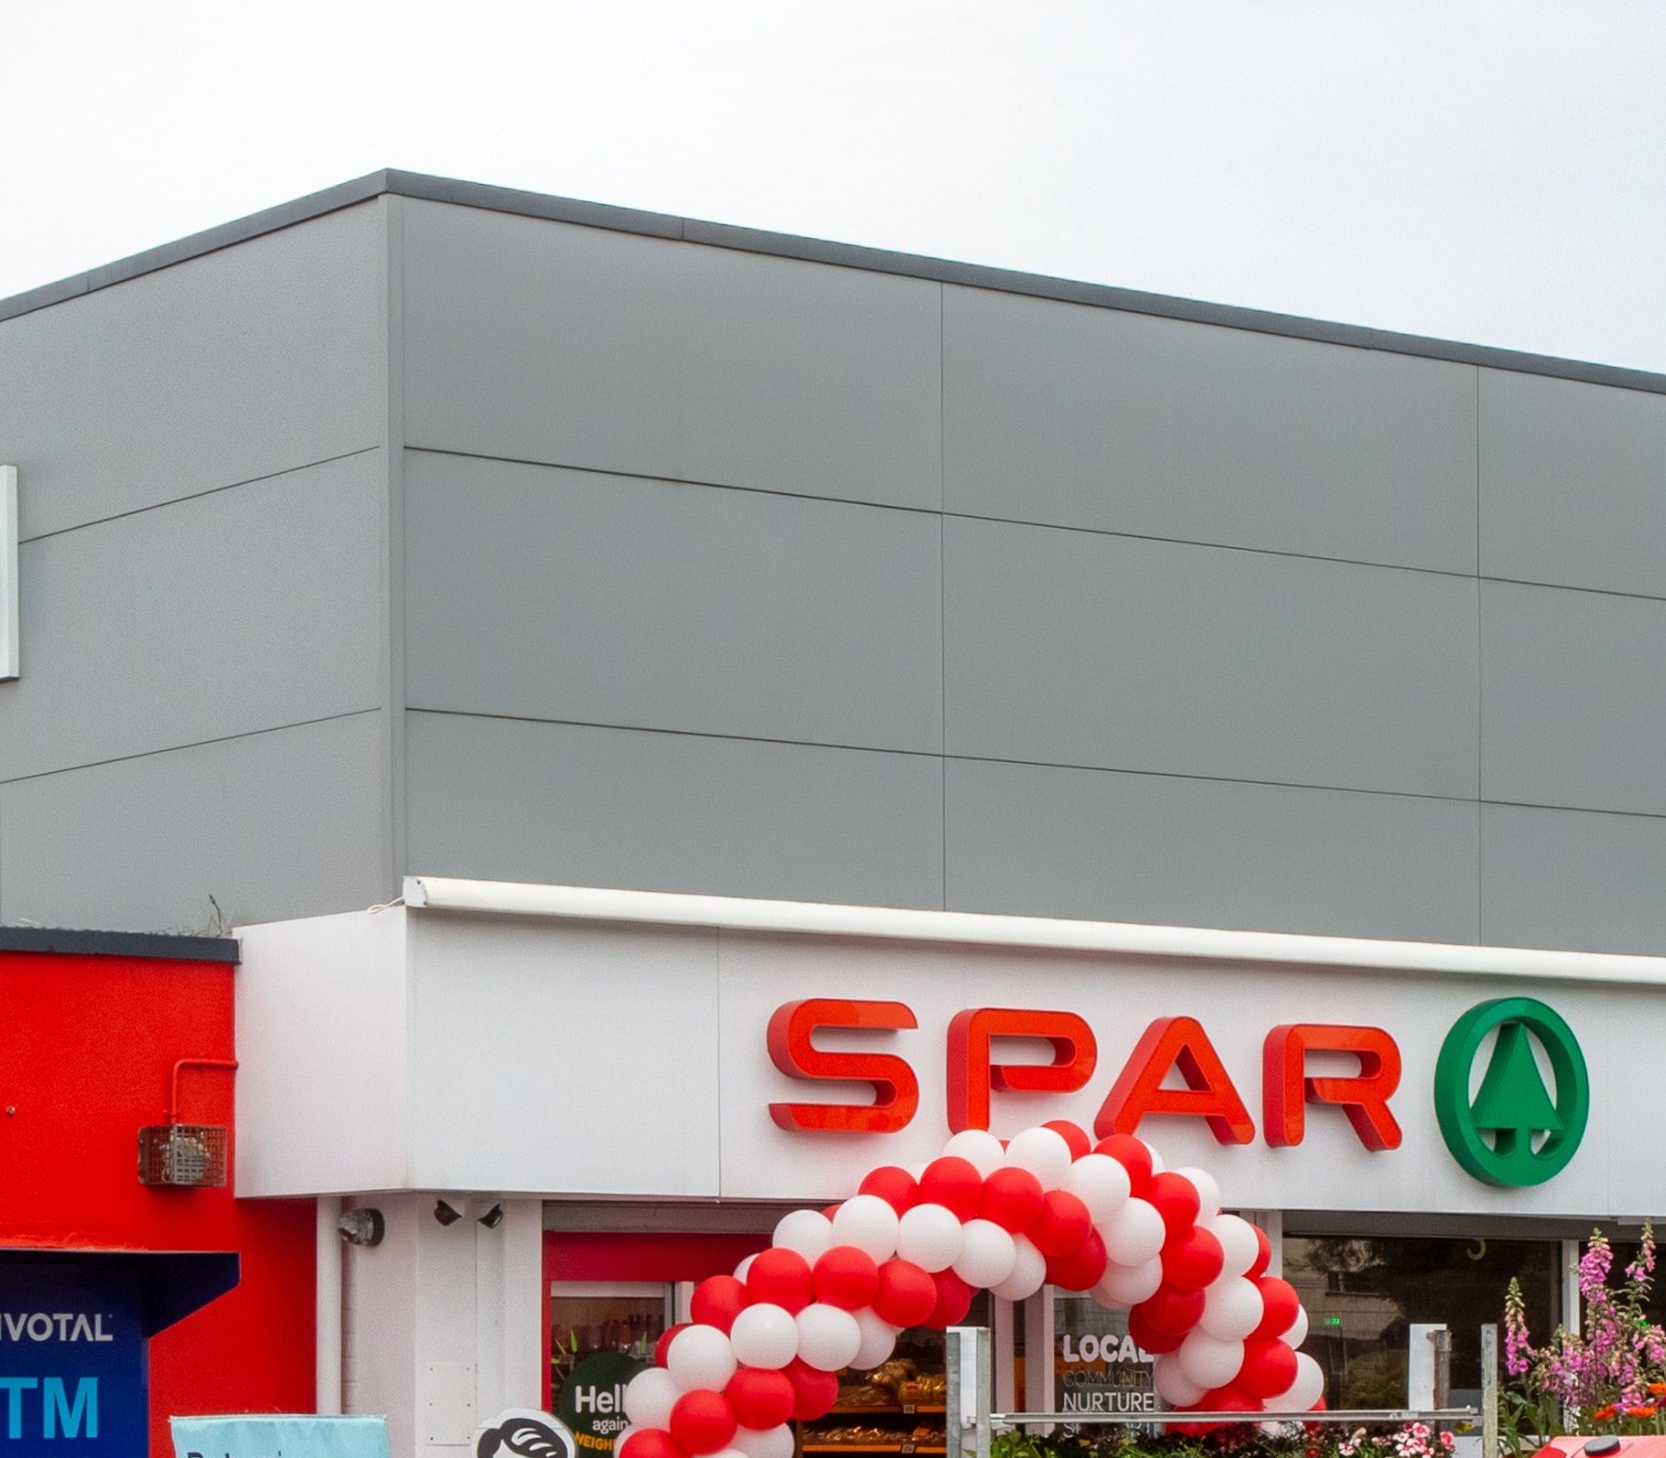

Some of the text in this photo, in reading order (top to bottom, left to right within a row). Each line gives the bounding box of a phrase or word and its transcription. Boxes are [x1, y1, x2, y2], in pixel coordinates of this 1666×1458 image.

[767, 998, 1403, 1152] SPAR
[1062, 1334, 1155, 1363] LOCAL
[1062, 1370, 1154, 1388] COMMUNITY
[575, 1384, 626, 1413] Hell
[1062, 1392, 1155, 1412] NURTURE
[592, 1416, 630, 1434] again
